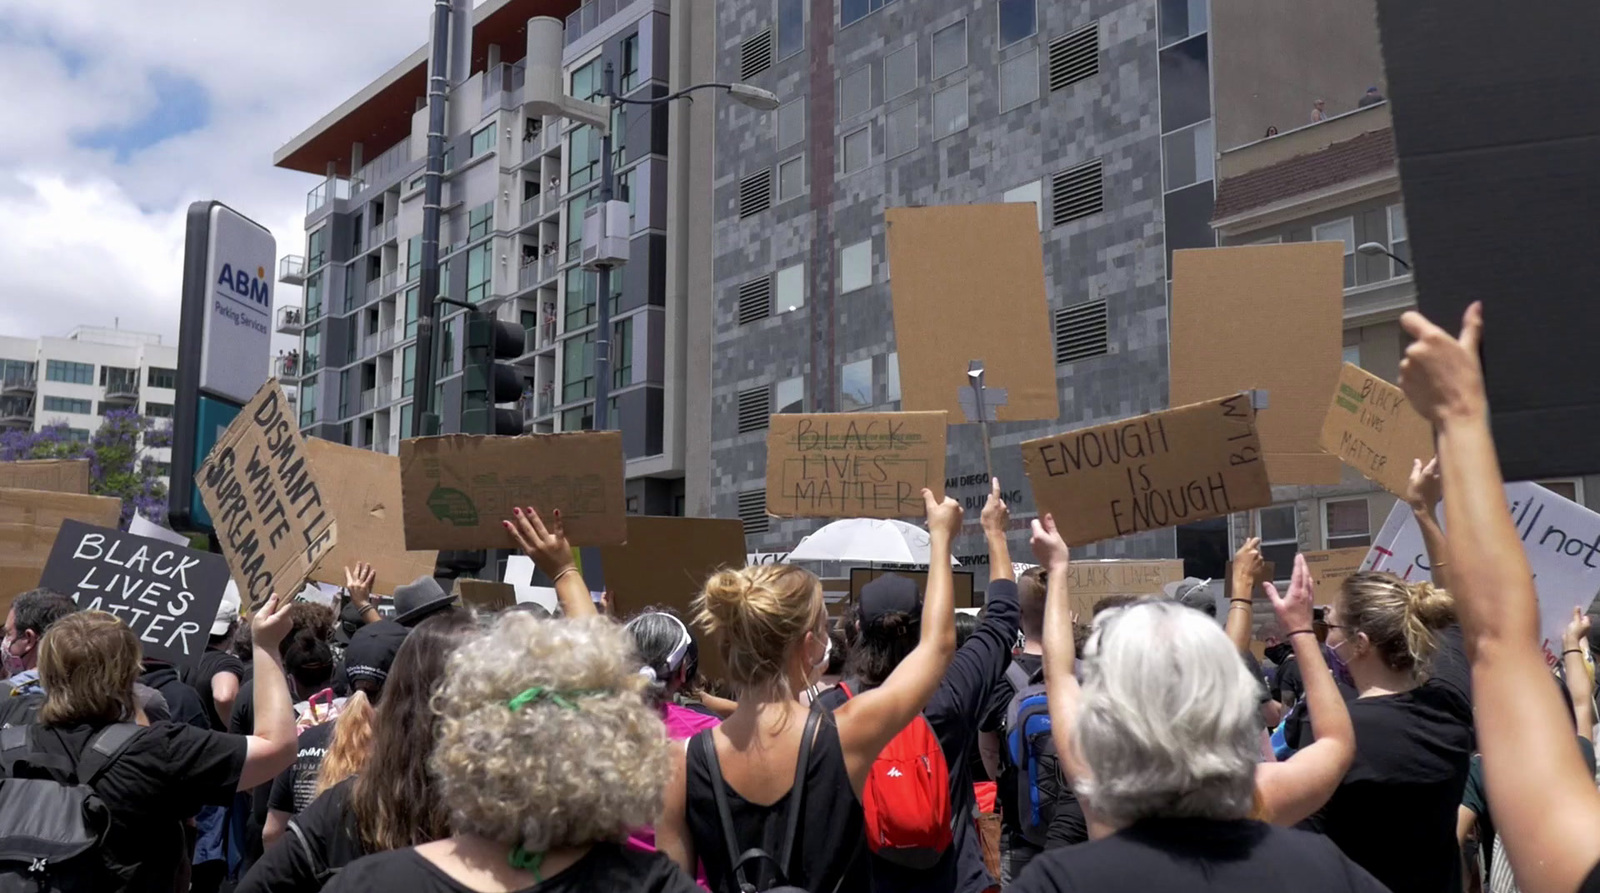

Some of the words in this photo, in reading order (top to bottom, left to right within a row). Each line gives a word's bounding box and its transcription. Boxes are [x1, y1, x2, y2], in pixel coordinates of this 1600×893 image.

[218, 263, 269, 308] ABM
[215, 301, 239, 326] Parking
[241, 312, 267, 334] Services
[1361, 378, 1404, 415] BLACK
[797, 418, 906, 452] BLACK
[1039, 418, 1169, 477] ENOUGH
[1340, 431, 1388, 474] MATTER
[254, 389, 331, 564] DISMANTLE
[803, 453, 888, 483] LIVES
[945, 477, 958, 488] AN
[960, 473, 989, 487] DIEGO
[1127, 464, 1151, 495] IS
[245, 445, 290, 549] WHITE
[795, 481, 923, 512] MATTER
[73, 533, 200, 589] BLACK
[1539, 525, 1600, 568] not
[77, 566, 195, 616] LIVES
[1067, 566, 1112, 588] BLACK
[1122, 566, 1163, 586] LIVES
